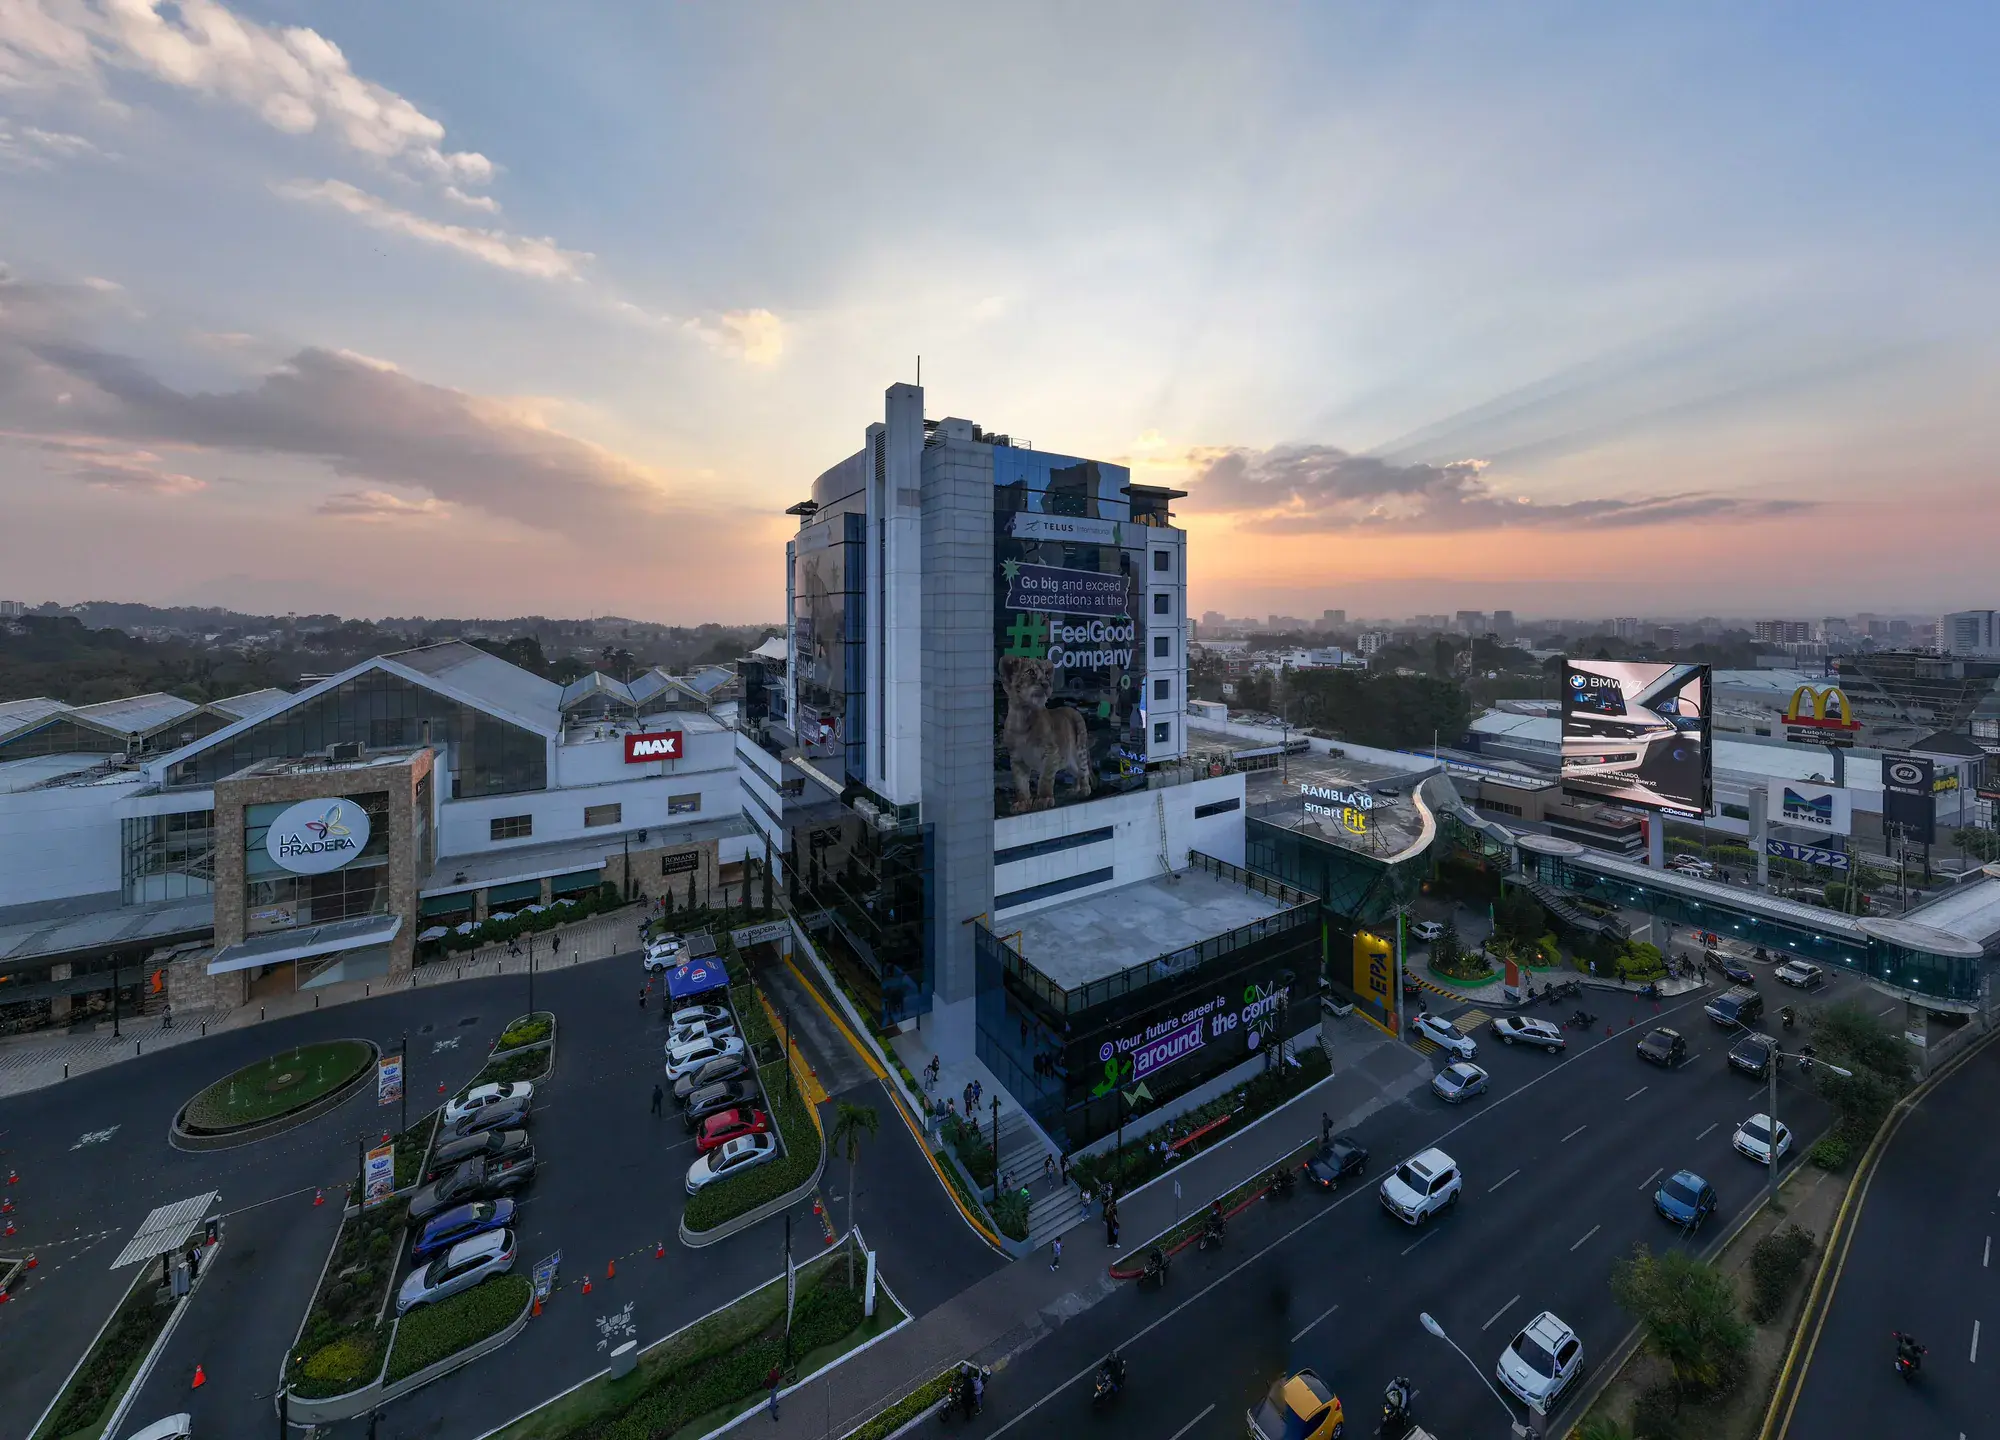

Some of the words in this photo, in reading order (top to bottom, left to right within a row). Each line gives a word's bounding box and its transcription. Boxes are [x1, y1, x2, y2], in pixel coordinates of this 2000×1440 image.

[1043, 522, 1074, 532] TELUS
[1076, 525, 1110, 536] International
[1021, 576, 1038, 589] Go
[1041, 577, 1059, 591] big
[1062, 579, 1083, 591] and
[1085, 580, 1121, 591] exceed
[1019, 593, 1092, 607] expectations
[1094, 595, 1106, 606] at
[1107, 595, 1123, 606] the
[1047, 645, 1134, 672] Company
[1590, 677, 1622, 689] BMW
[632, 738, 676, 756] MAX
[1898, 770, 1915, 778] BI
[1301, 784, 1356, 805] RAMBLA
[1359, 796, 1373, 808] 10
[1304, 802, 1341, 819] smart
[1343, 807, 1367, 830] fit
[1659, 806, 1695, 818] JCDecaux
[1783, 811, 1832, 825] MEYKOS
[279, 836, 357, 858] PRADERA
[280, 832, 303, 846] LA
[1790, 845, 1848, 870] 1722
[737, 931, 748, 940] LA
[1368, 952, 1388, 997] EPA
[1115, 1034, 1142, 1053] Your
[1145, 1018, 1179, 1040] future
[1181, 1001, 1215, 1023] career
[1216, 995, 1226, 1007] is
[1138, 1023, 1200, 1071] around
[1211, 1011, 1238, 1036] the
